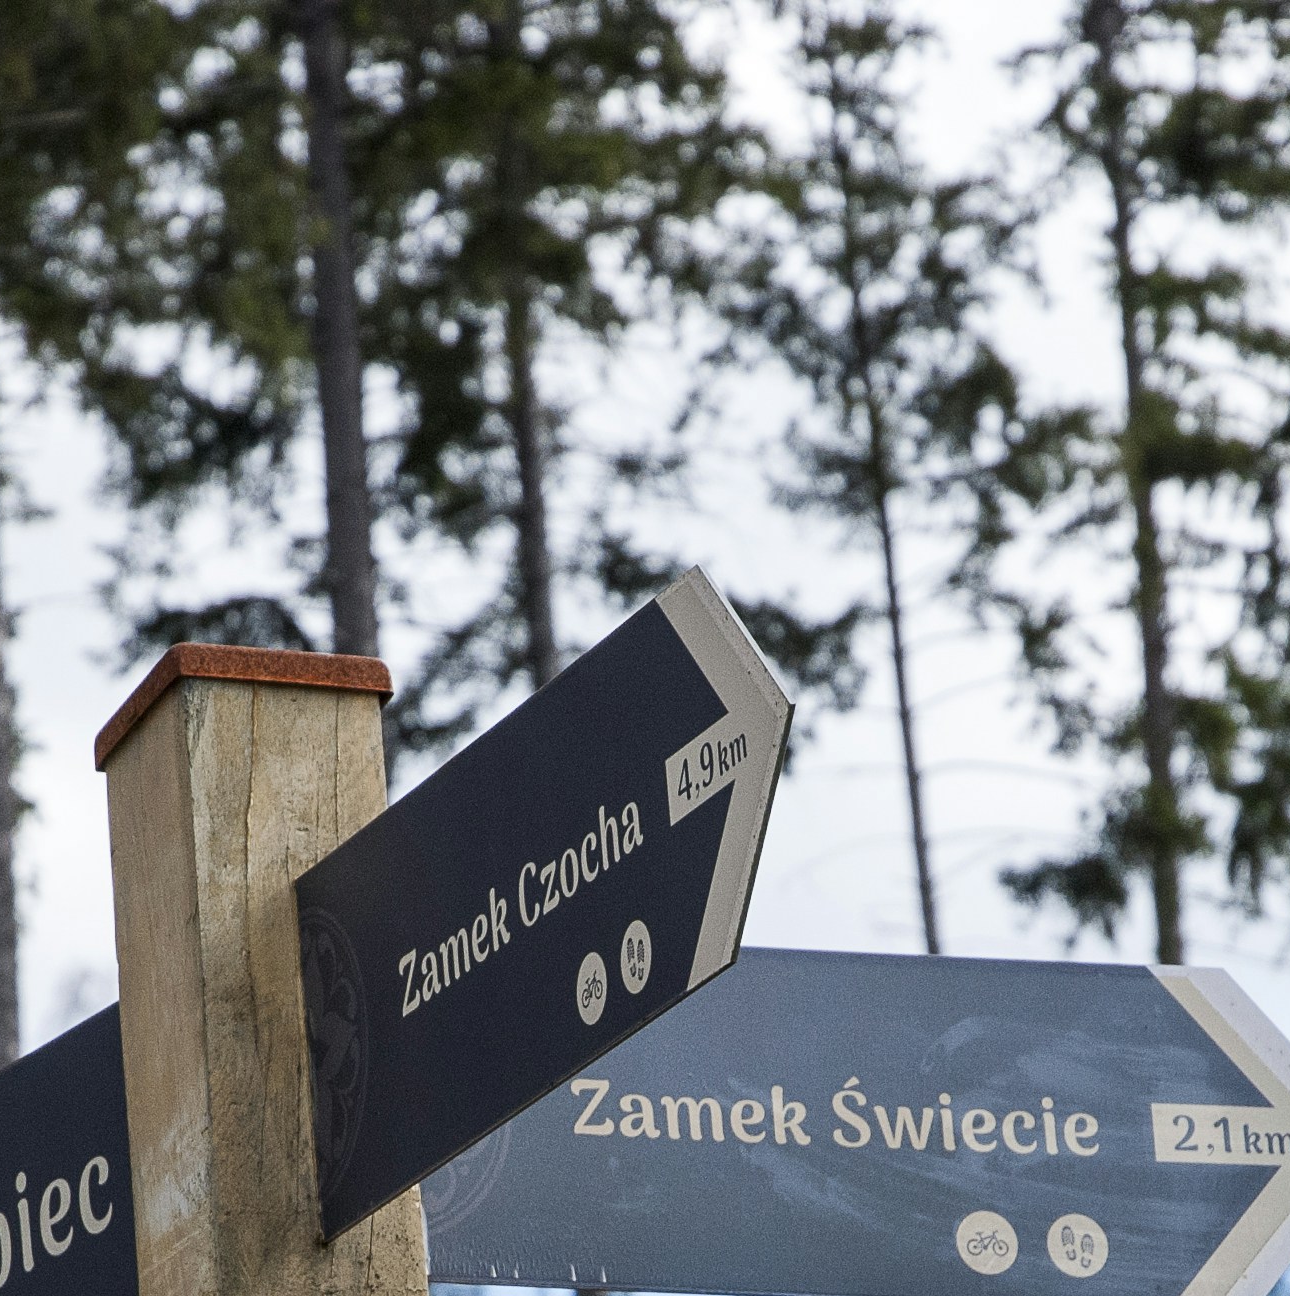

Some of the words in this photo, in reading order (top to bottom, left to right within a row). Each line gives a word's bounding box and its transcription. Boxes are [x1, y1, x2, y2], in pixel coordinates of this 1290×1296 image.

[717, 733, 747, 776] km
[398, 887, 511, 1018] Zamek
[518, 801, 644, 927] Czocha
[571, 1077, 812, 1147] Zamek
[831, 1075, 1102, 1157] Świecie
